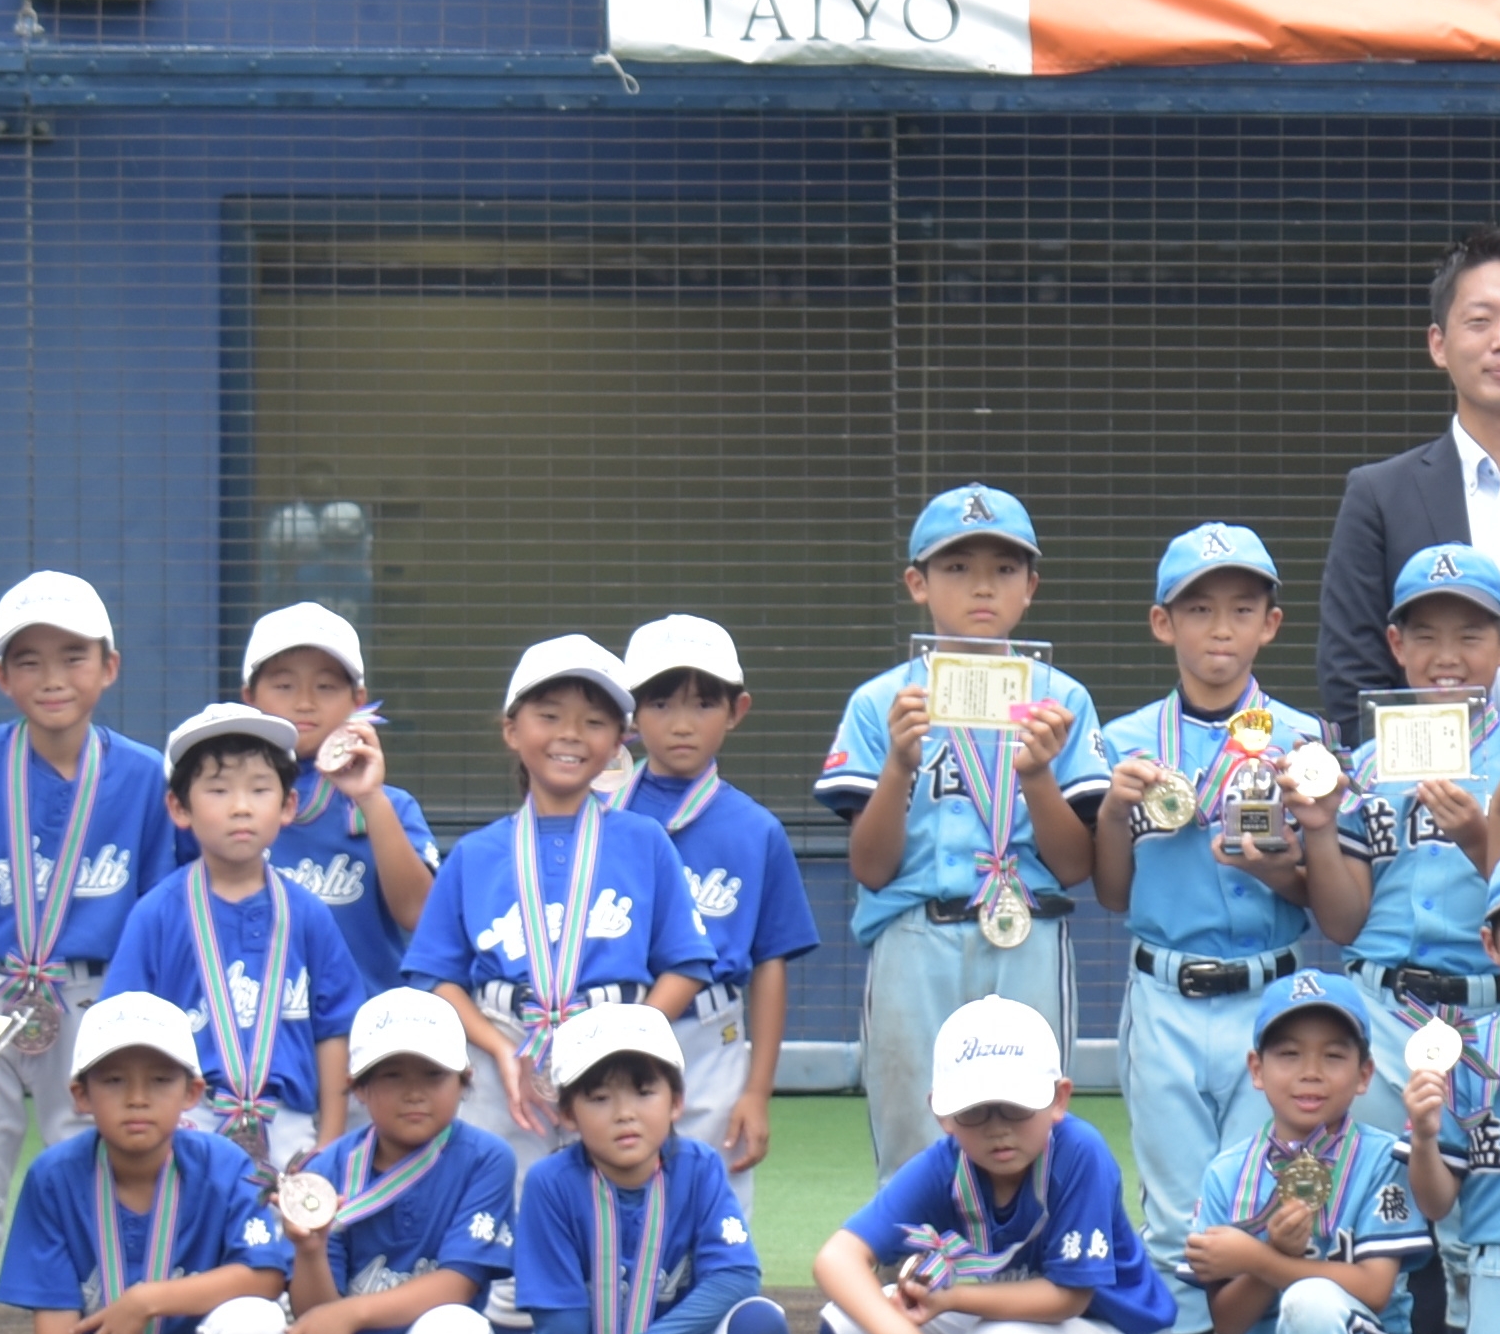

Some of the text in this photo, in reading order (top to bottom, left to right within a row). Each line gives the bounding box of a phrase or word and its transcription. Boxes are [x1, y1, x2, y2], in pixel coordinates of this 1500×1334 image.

[962, 493, 994, 525] A
[1201, 529, 1236, 560] A
[1428, 551, 1463, 582] A
[1288, 969, 1326, 1001] A
[955, 1036, 1025, 1064] Aizumi
[1060, 1227, 1109, 1260] 徳島
